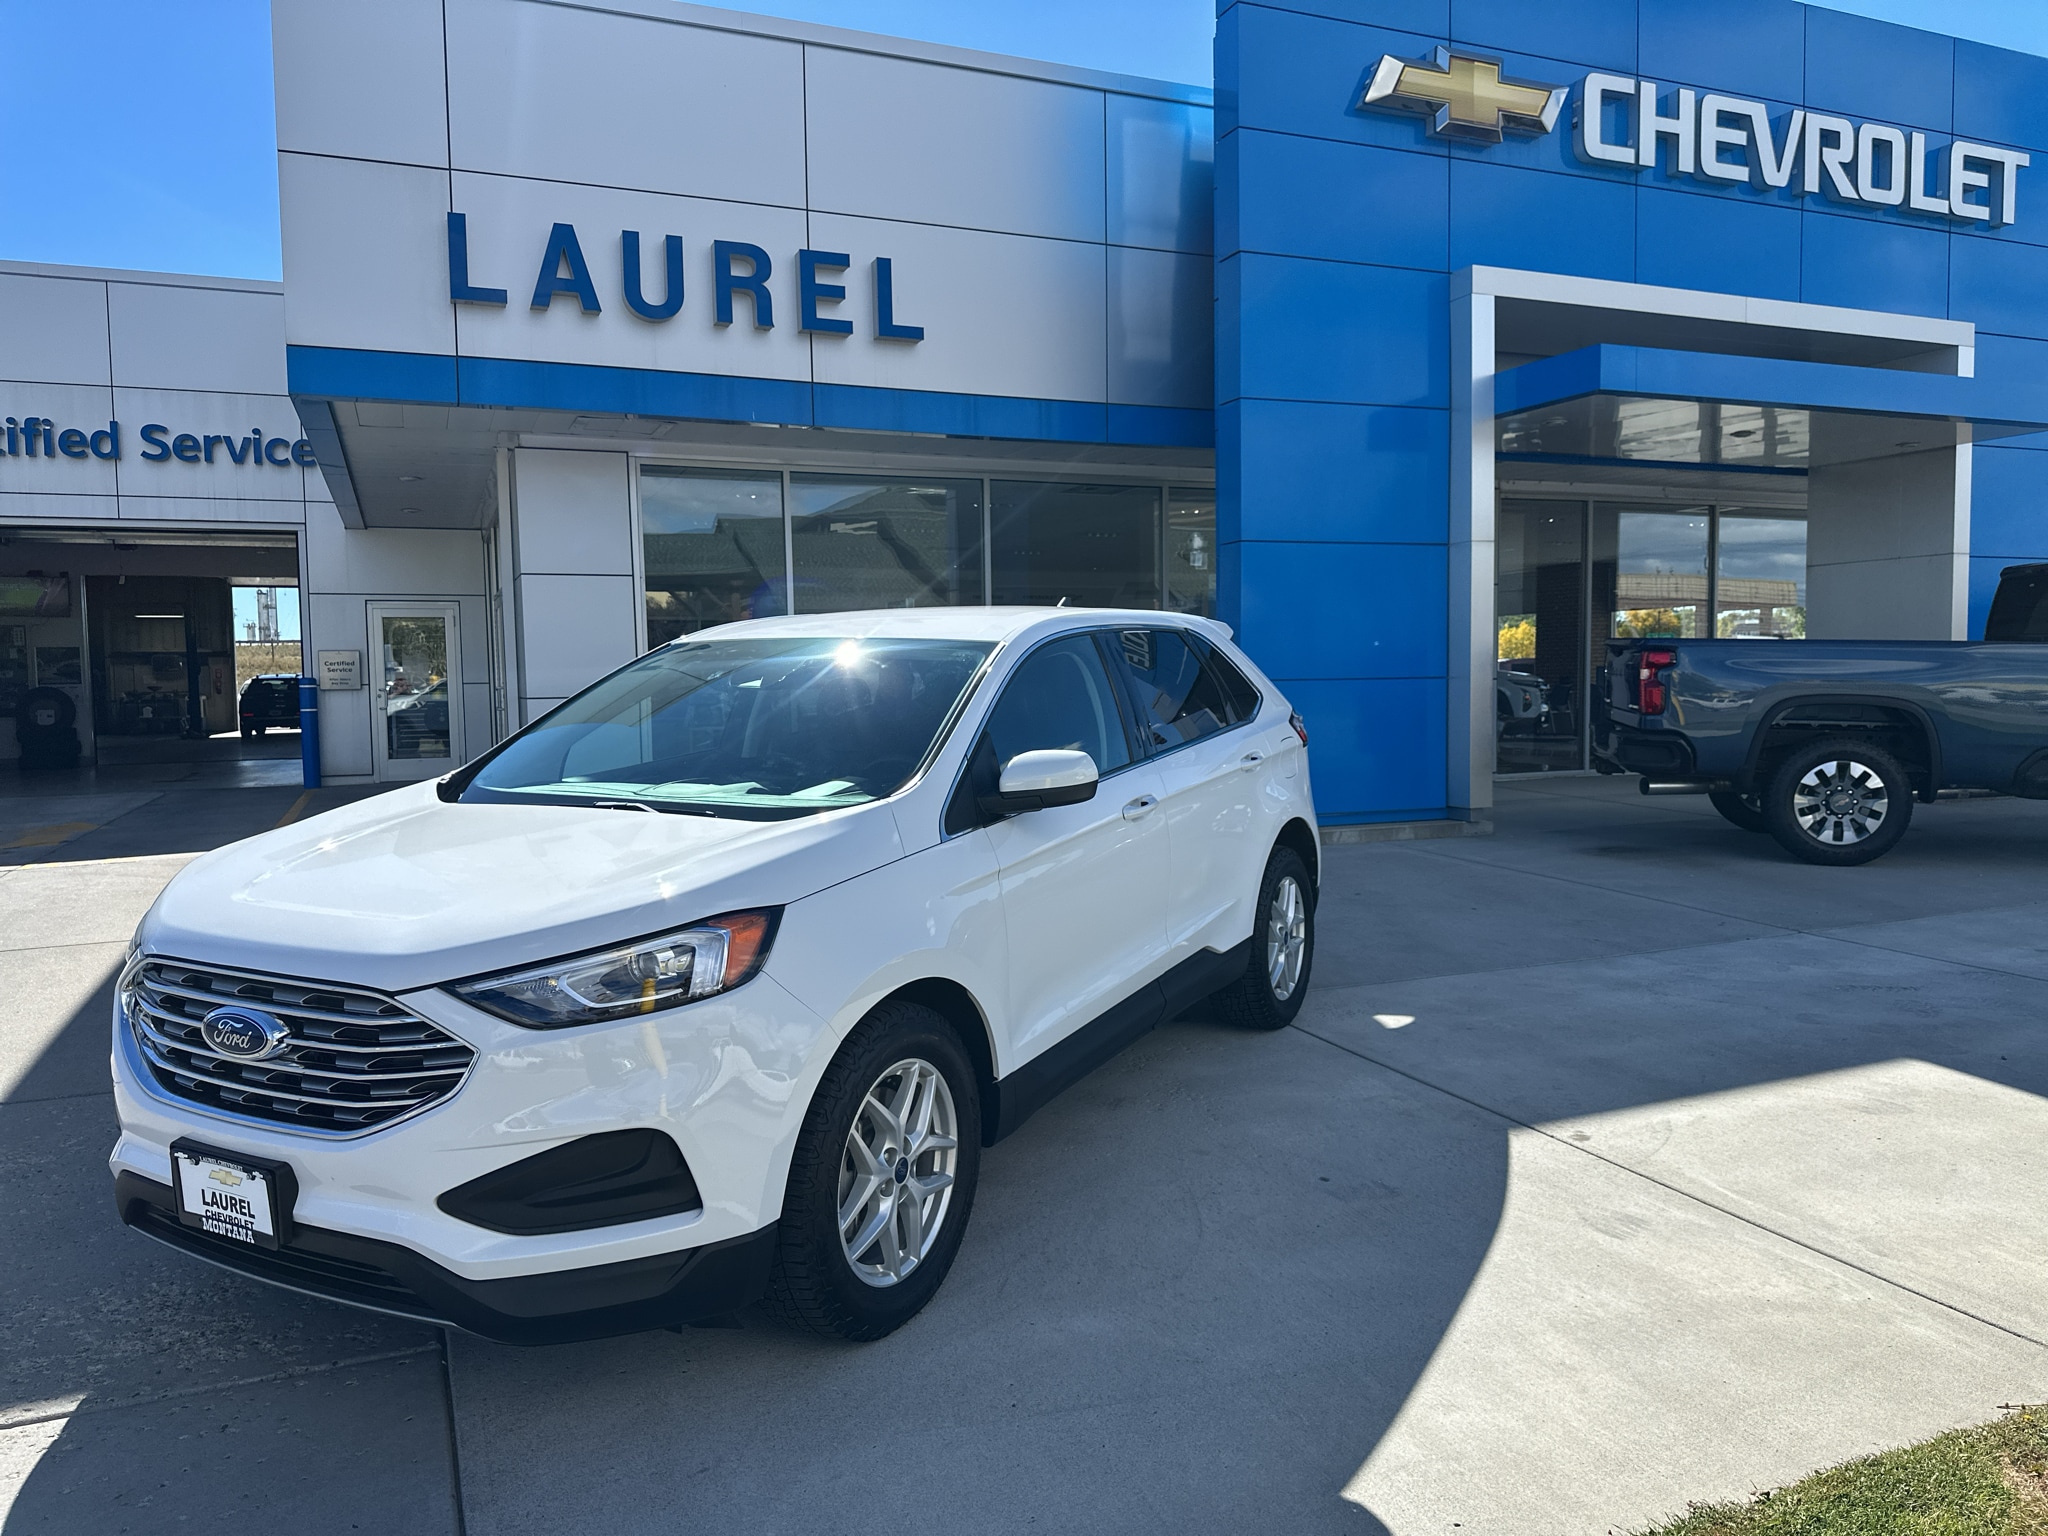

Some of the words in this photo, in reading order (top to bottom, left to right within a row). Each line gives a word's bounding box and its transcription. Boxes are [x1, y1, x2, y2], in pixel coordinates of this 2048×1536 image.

[1579, 72, 2030, 226] CHEVROLET
[447, 211, 925, 343] LAUREL
[140, 423, 318, 468] Service
[213, 1018, 253, 1049] Ford
[201, 1188, 256, 1219] LAUREL
[205, 1209, 254, 1229] CHEVROLET
[202, 1217, 255, 1244] MONTANA
